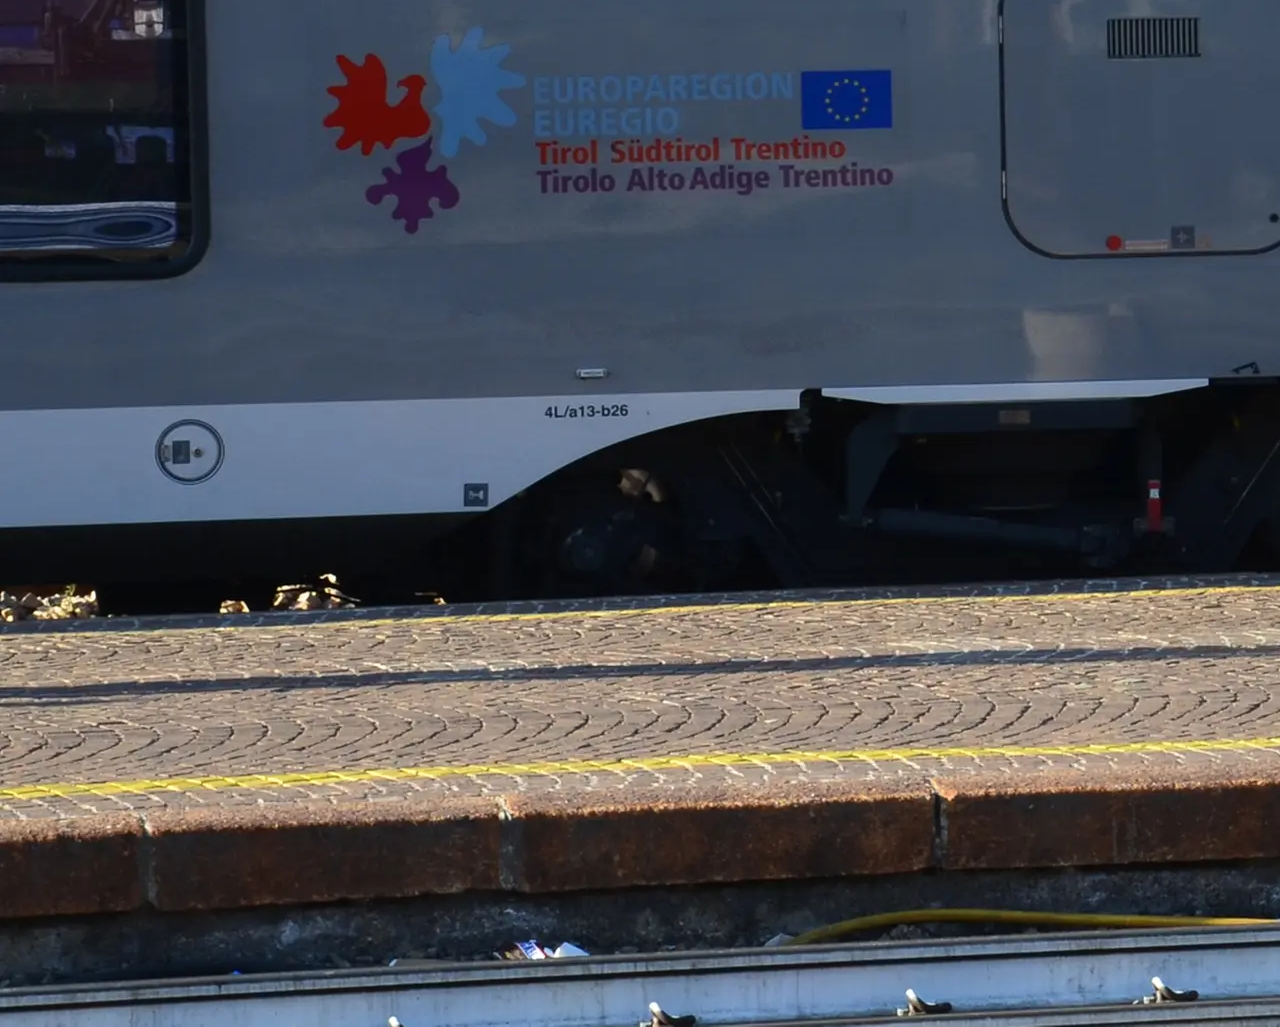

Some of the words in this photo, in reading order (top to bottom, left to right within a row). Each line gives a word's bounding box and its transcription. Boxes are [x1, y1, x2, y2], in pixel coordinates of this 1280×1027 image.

[533, 72, 793, 105] EUROPAREGION
[533, 106, 680, 137] EUREGIO
[535, 140, 597, 165] Tirol
[611, 136, 719, 164] Südtirol
[730, 135, 846, 161] Trentino
[536, 169, 616, 194] Tirolo
[626, 167, 685, 192] Alto
[689, 165, 770, 196] Adige
[778, 162, 895, 188] Trentino
[544, 404, 629, 419] 4L/a13-b26
